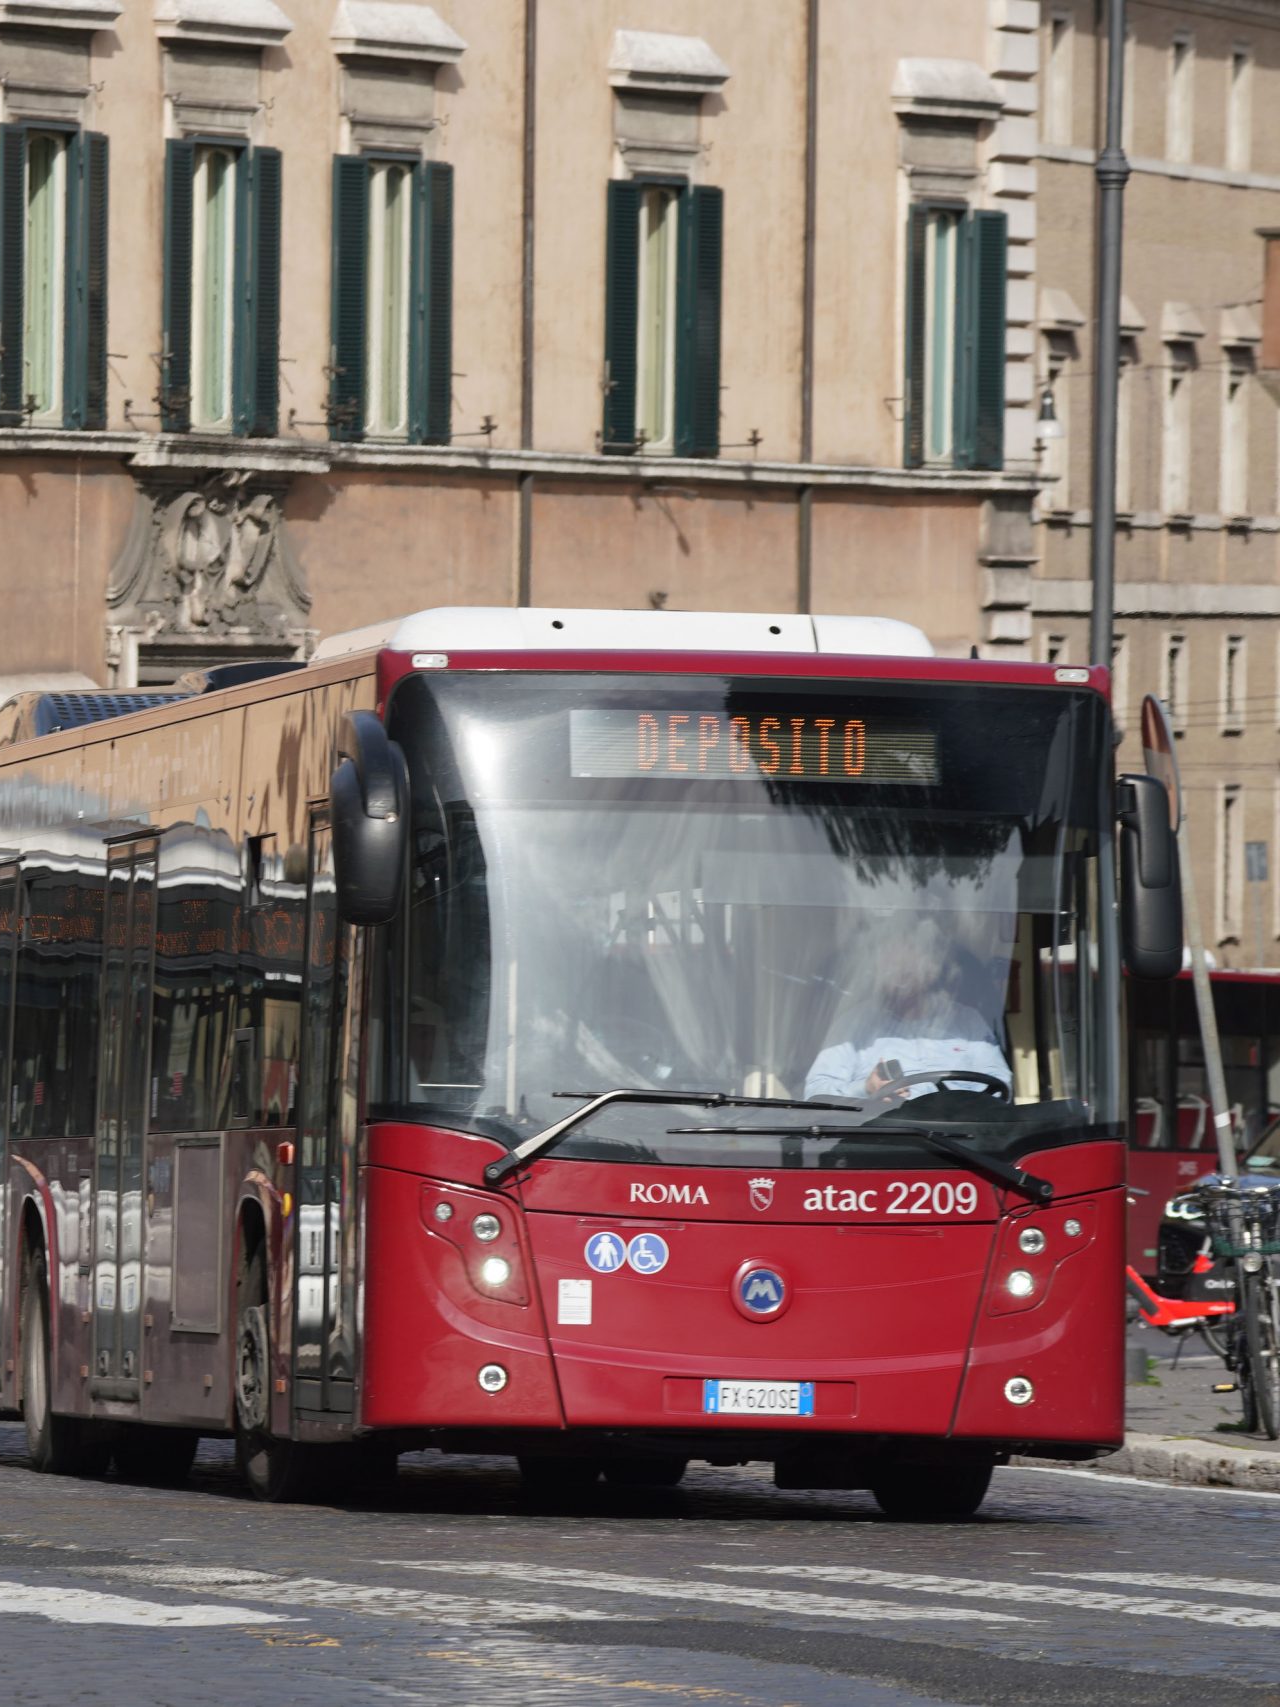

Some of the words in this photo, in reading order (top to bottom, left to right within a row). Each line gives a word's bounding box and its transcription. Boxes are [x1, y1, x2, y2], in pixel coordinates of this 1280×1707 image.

[638, 714, 866, 776] DEPOSITO
[629, 1182, 710, 1205] ROMA
[803, 1184, 878, 1212] atac
[885, 1181, 978, 1215] 2209
